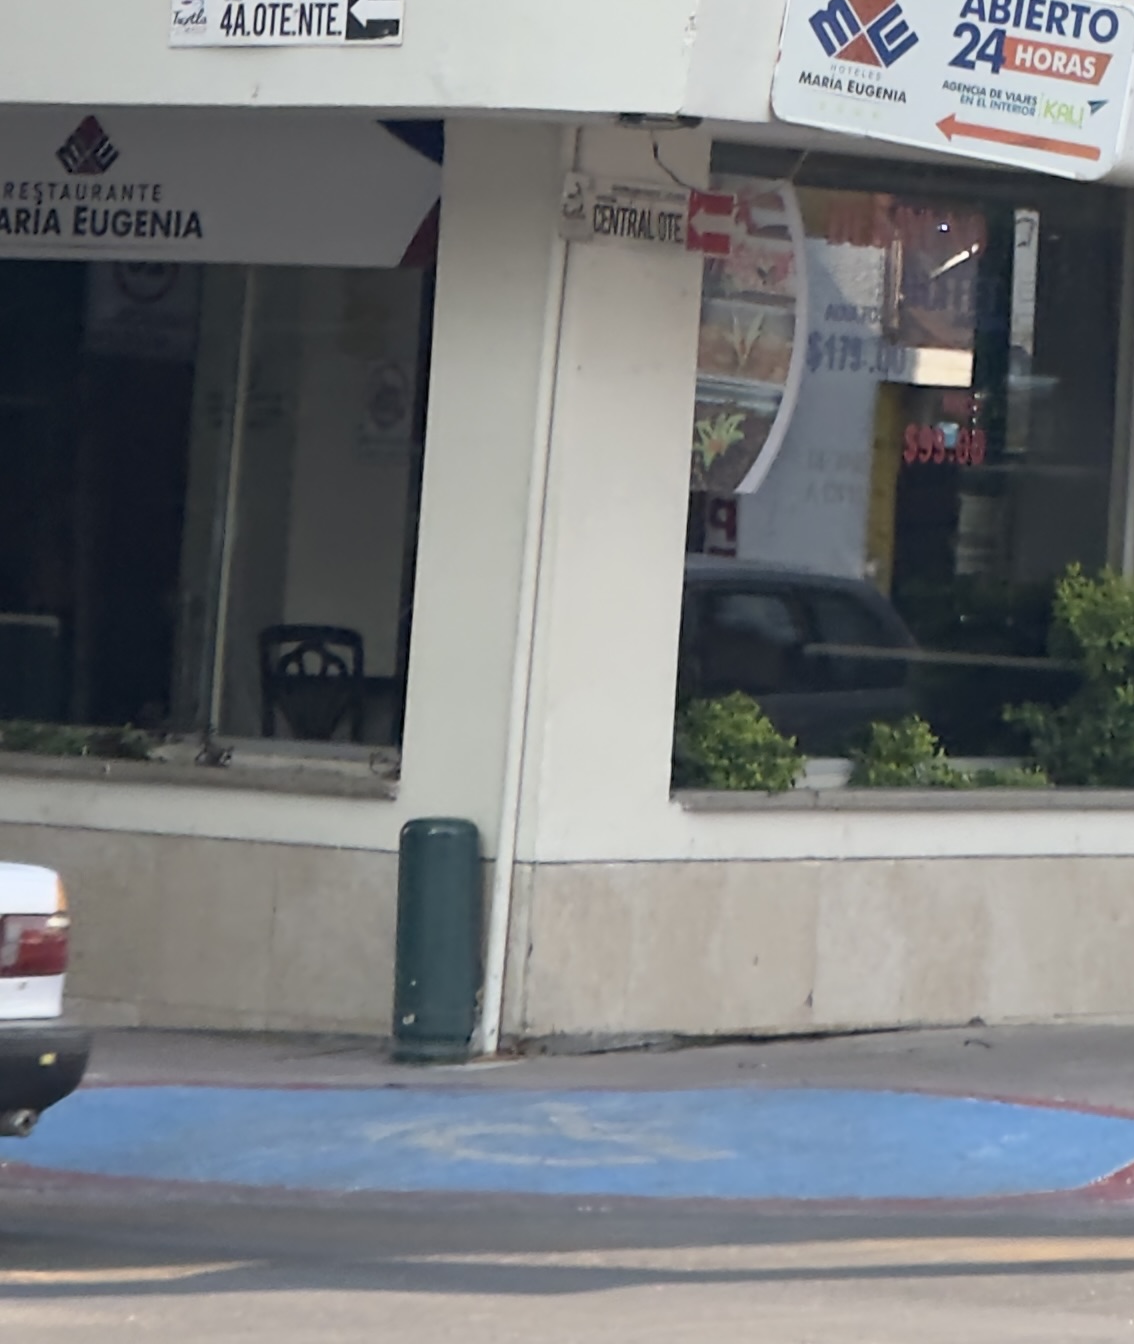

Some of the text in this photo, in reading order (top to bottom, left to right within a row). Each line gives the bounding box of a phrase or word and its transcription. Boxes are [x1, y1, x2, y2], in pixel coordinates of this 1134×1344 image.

[948, 22, 1096, 79] 24 HORAS
[847, 79, 907, 104] EUGENIA
[942, 80, 1038, 106] AGENCIA DE VIAJES
[960, 94, 1036, 117] EN EL INTERIOR
[3, 181, 163, 202] RESTAURANTE
[72, 205, 203, 239] EUGENIA
[593, 203, 655, 241] CENTRAL
